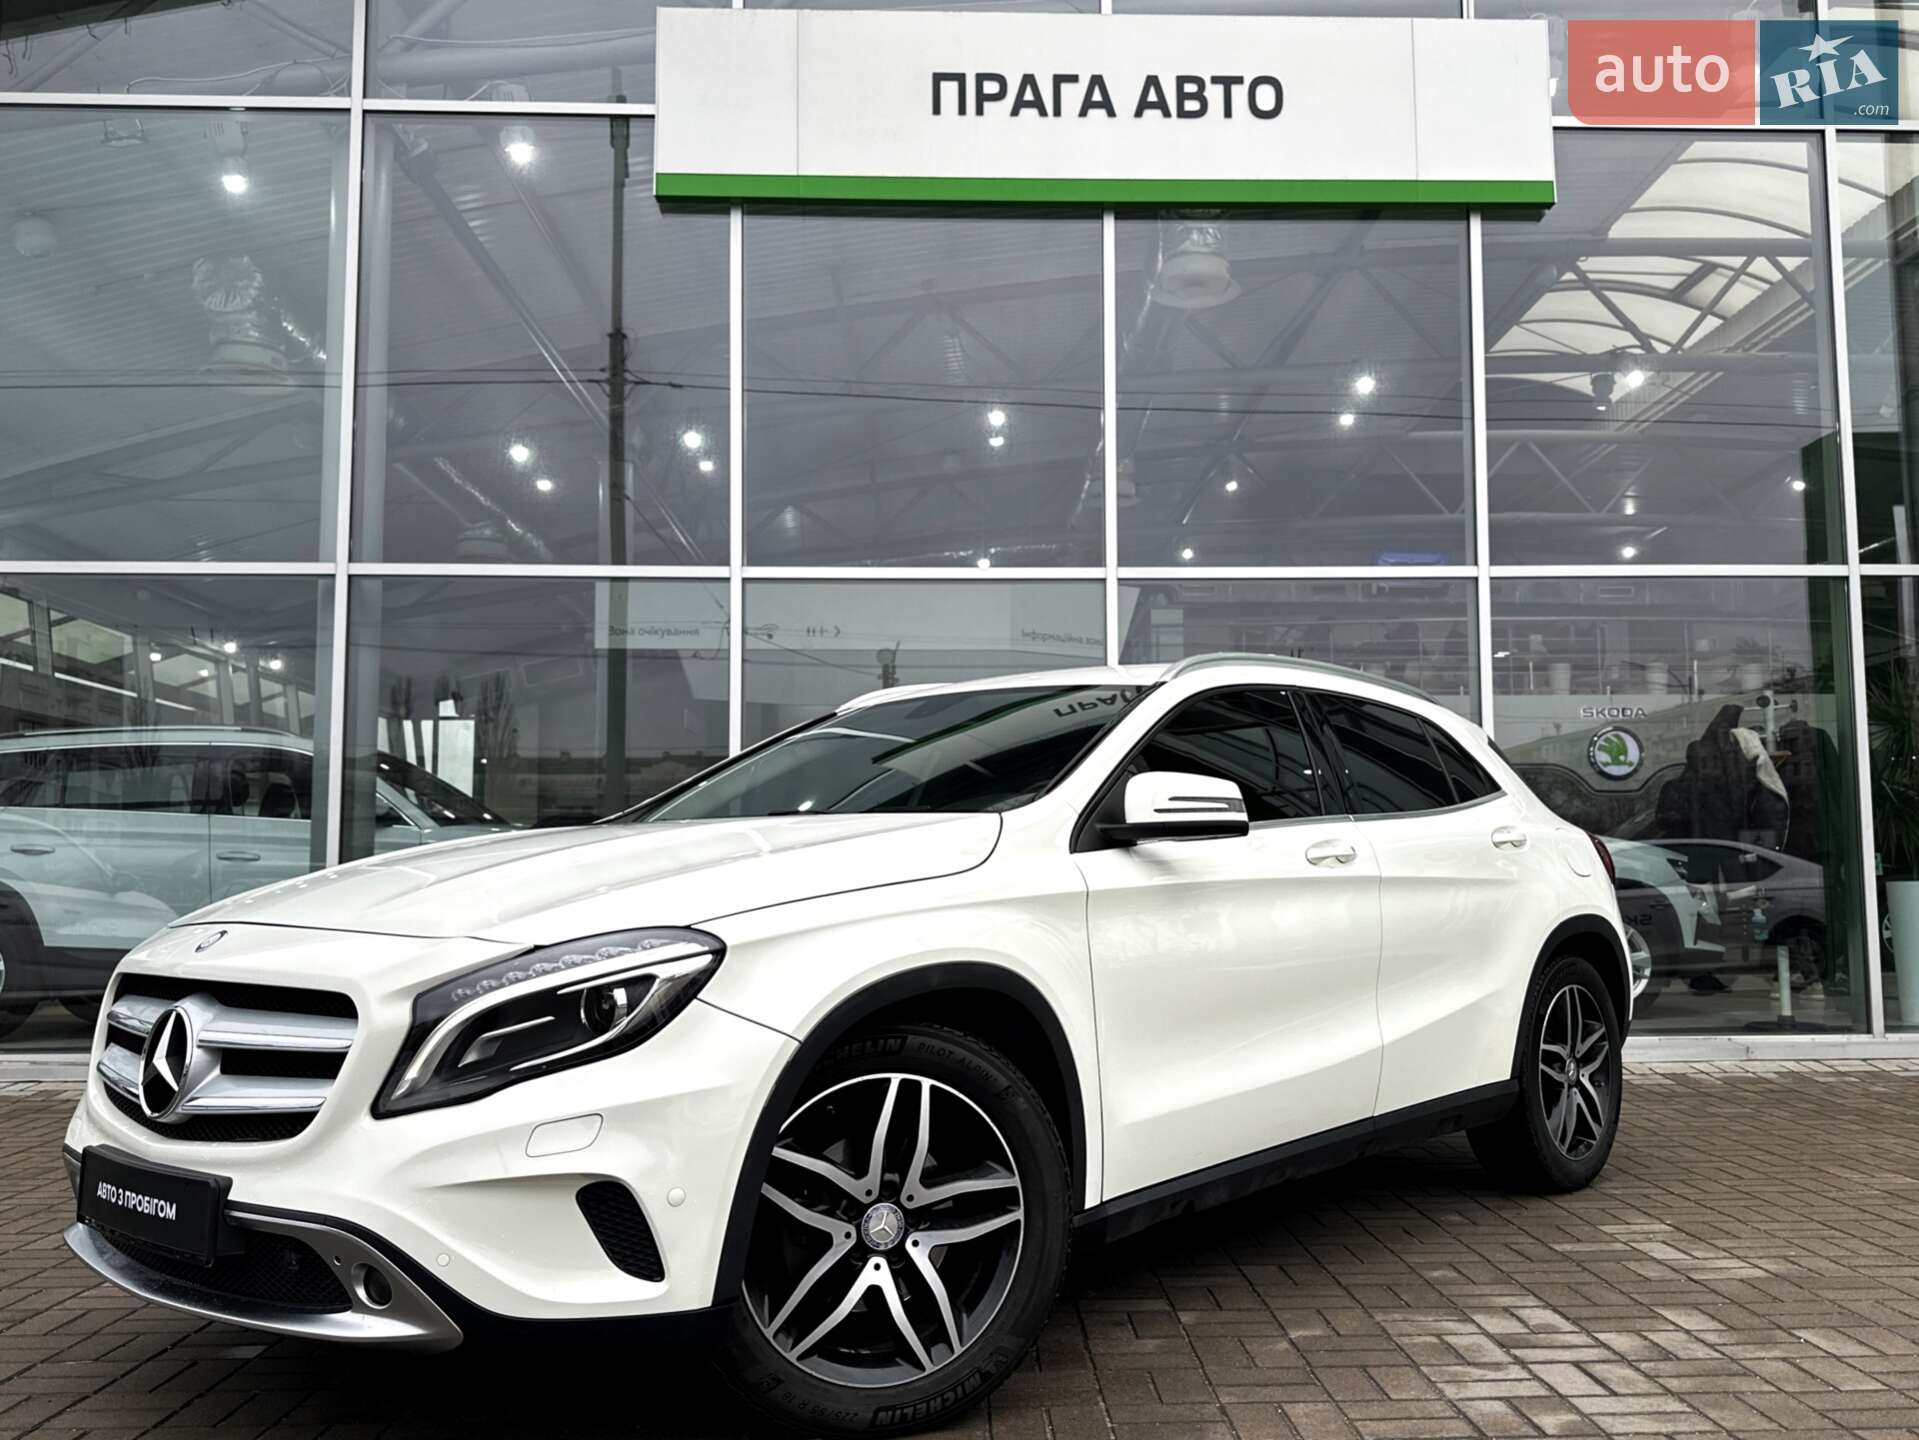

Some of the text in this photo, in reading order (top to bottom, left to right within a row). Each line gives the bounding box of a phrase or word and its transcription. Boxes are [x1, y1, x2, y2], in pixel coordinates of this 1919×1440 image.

[932, 72, 1285, 120] ПРАГА АВТО
[97, 1181, 117, 1204] АВТО
[124, 1191, 177, 1221] ПРОБІГОМ
[875, 1372, 983, 1425] MICHELIN
